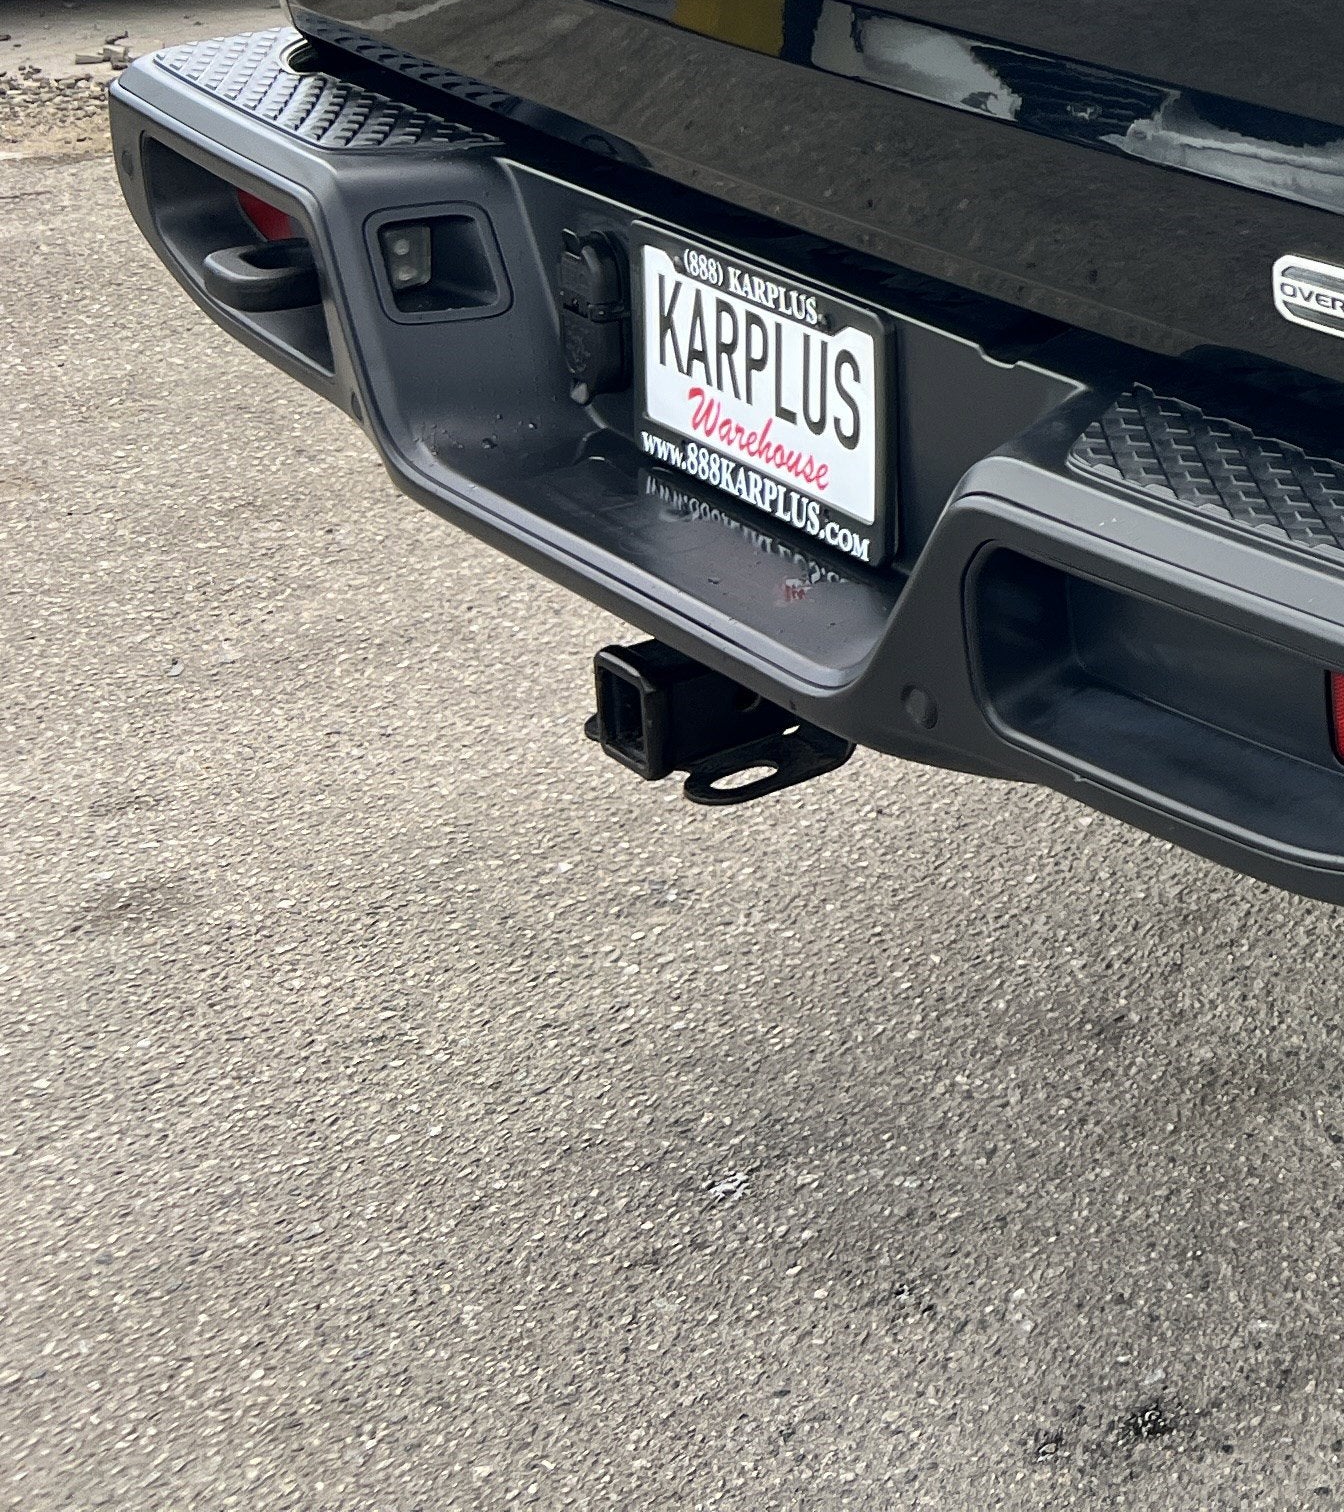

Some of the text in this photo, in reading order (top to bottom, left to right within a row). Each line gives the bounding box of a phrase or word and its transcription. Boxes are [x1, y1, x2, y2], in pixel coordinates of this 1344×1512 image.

[683, 248, 818, 325] (888) KARPLUS
[658, 273, 861, 450] KARPLUS
[640, 430, 871, 562] www.888KARPLUS.COM
[688, 387, 830, 491] Warehouse
